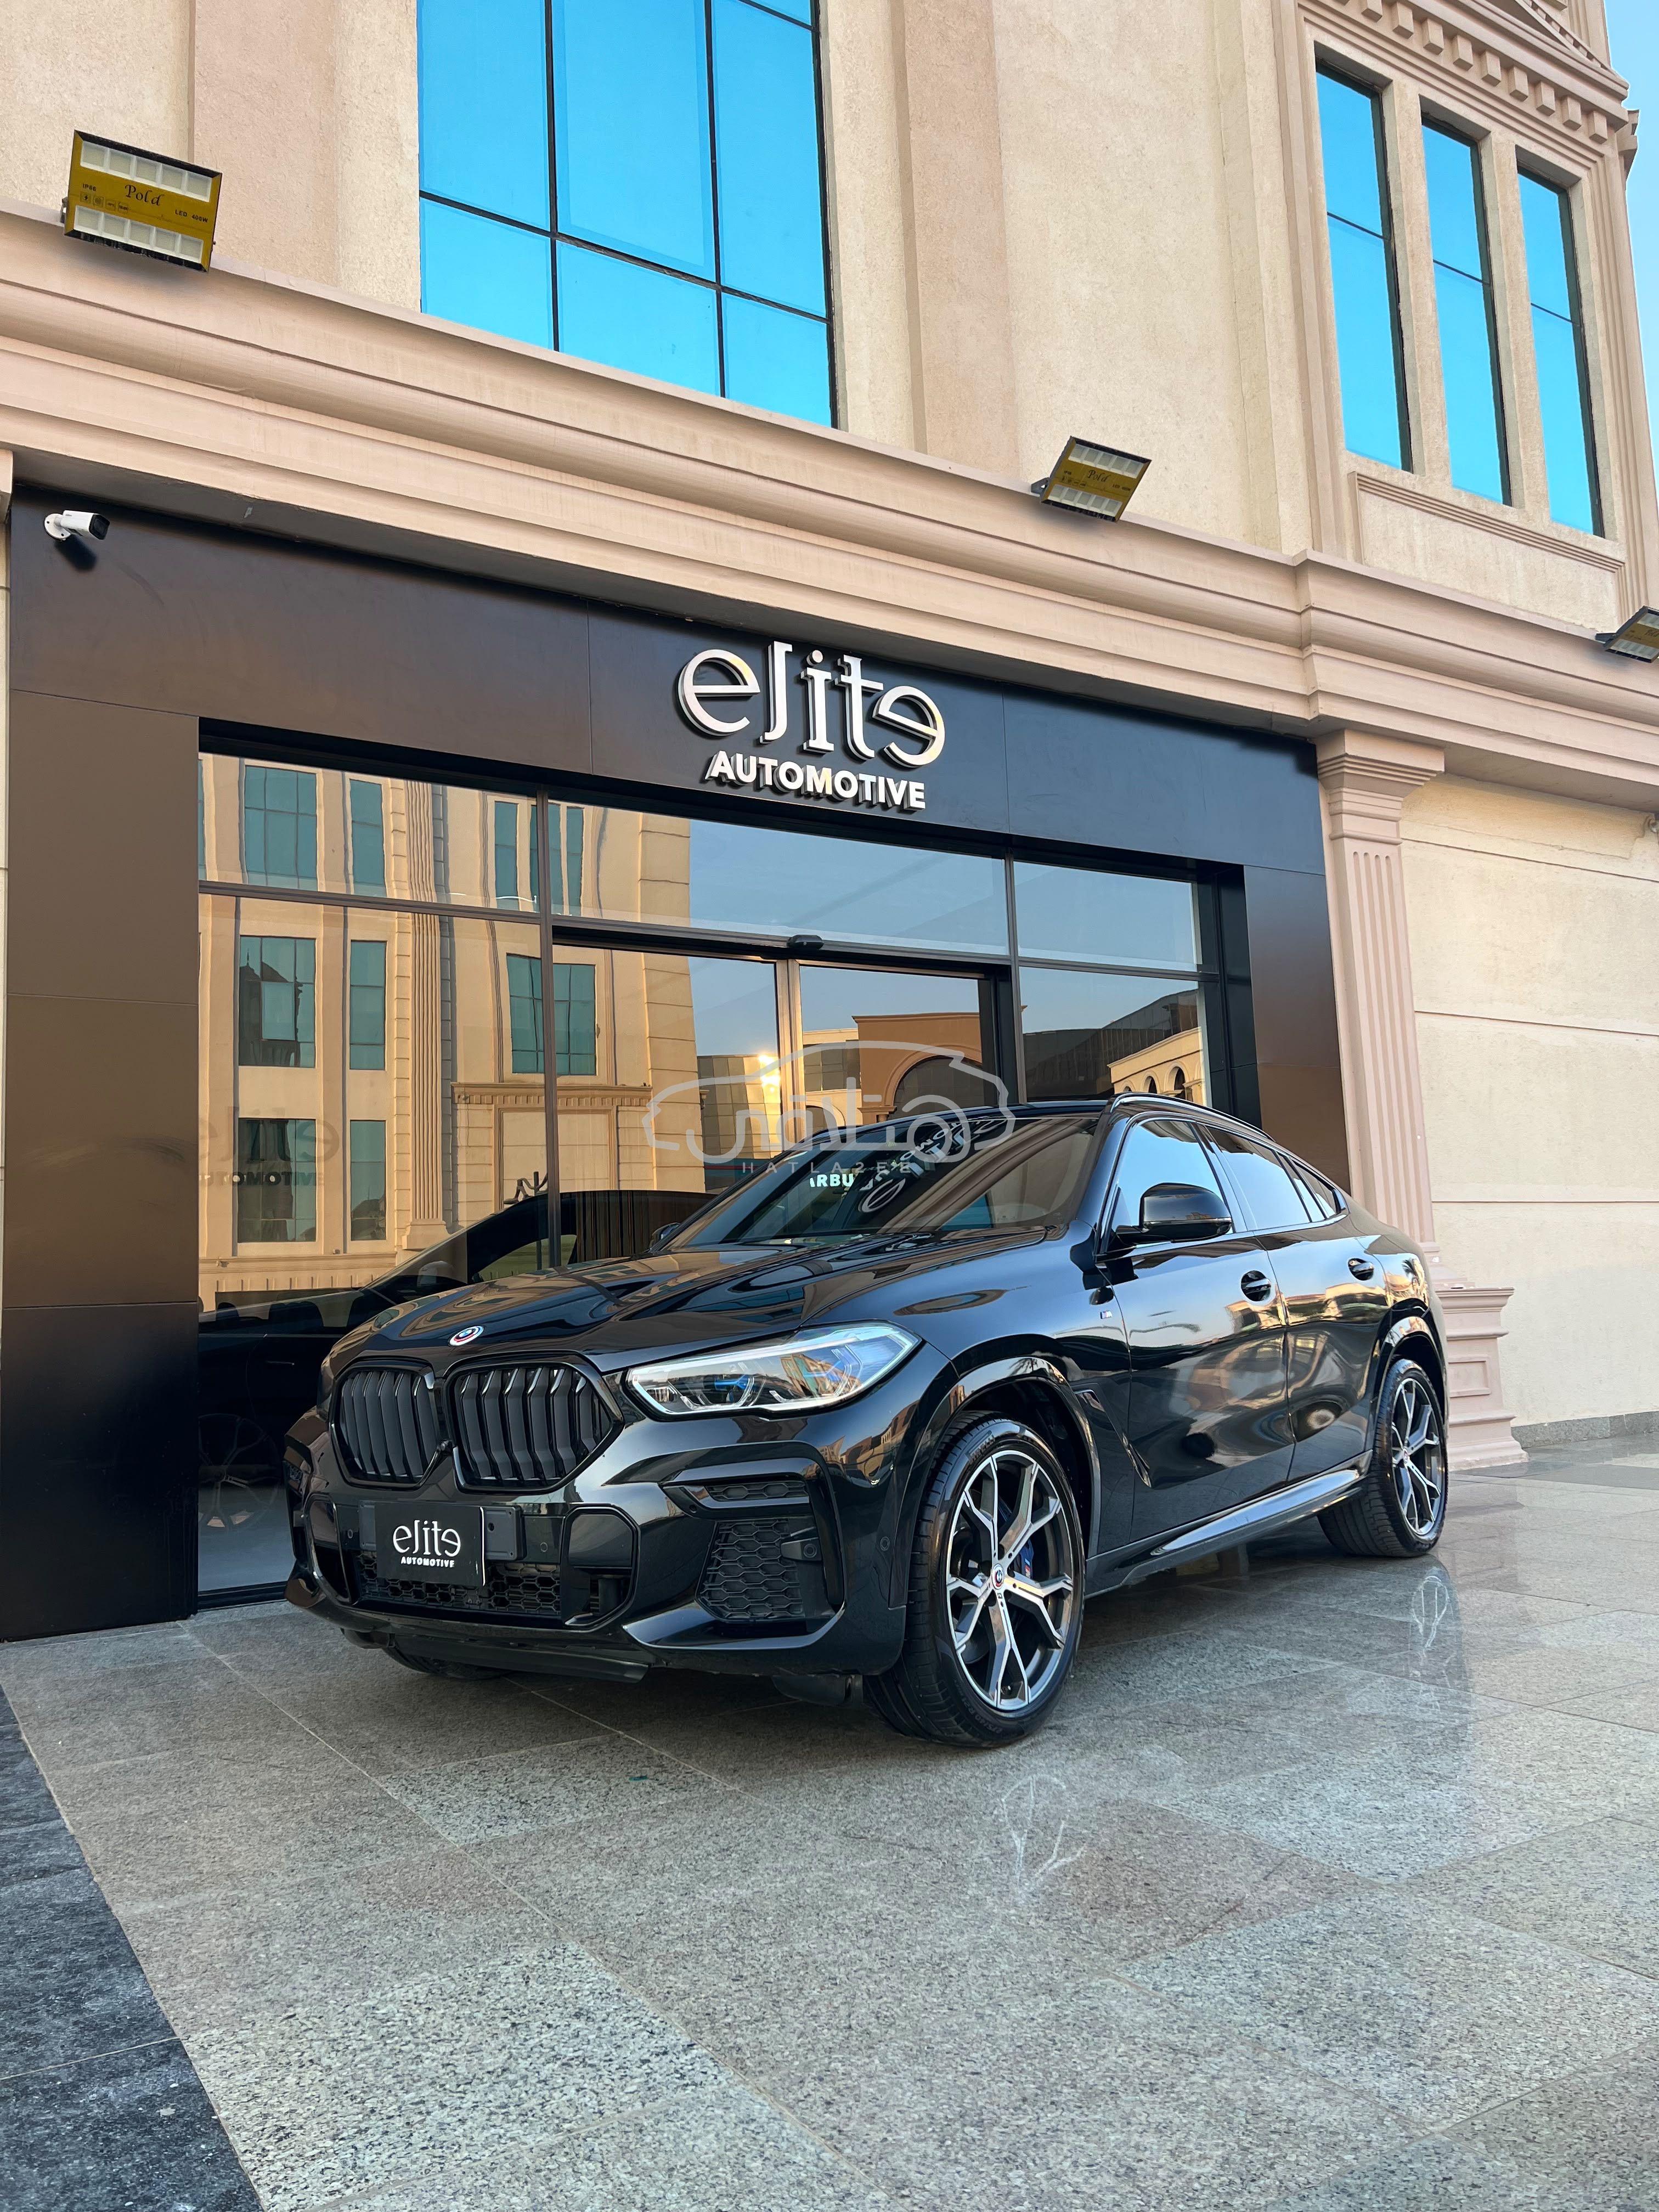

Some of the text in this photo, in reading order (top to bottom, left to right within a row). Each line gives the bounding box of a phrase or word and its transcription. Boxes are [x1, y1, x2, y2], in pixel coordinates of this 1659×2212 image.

[125, 184, 164, 206] Pold
[678, 641, 945, 768] elite
[705, 750, 926, 811] AUTOMOTIVE
[393, 1520, 461, 1557] elite
[400, 1556, 455, 1568] AUTOMOTIVE
